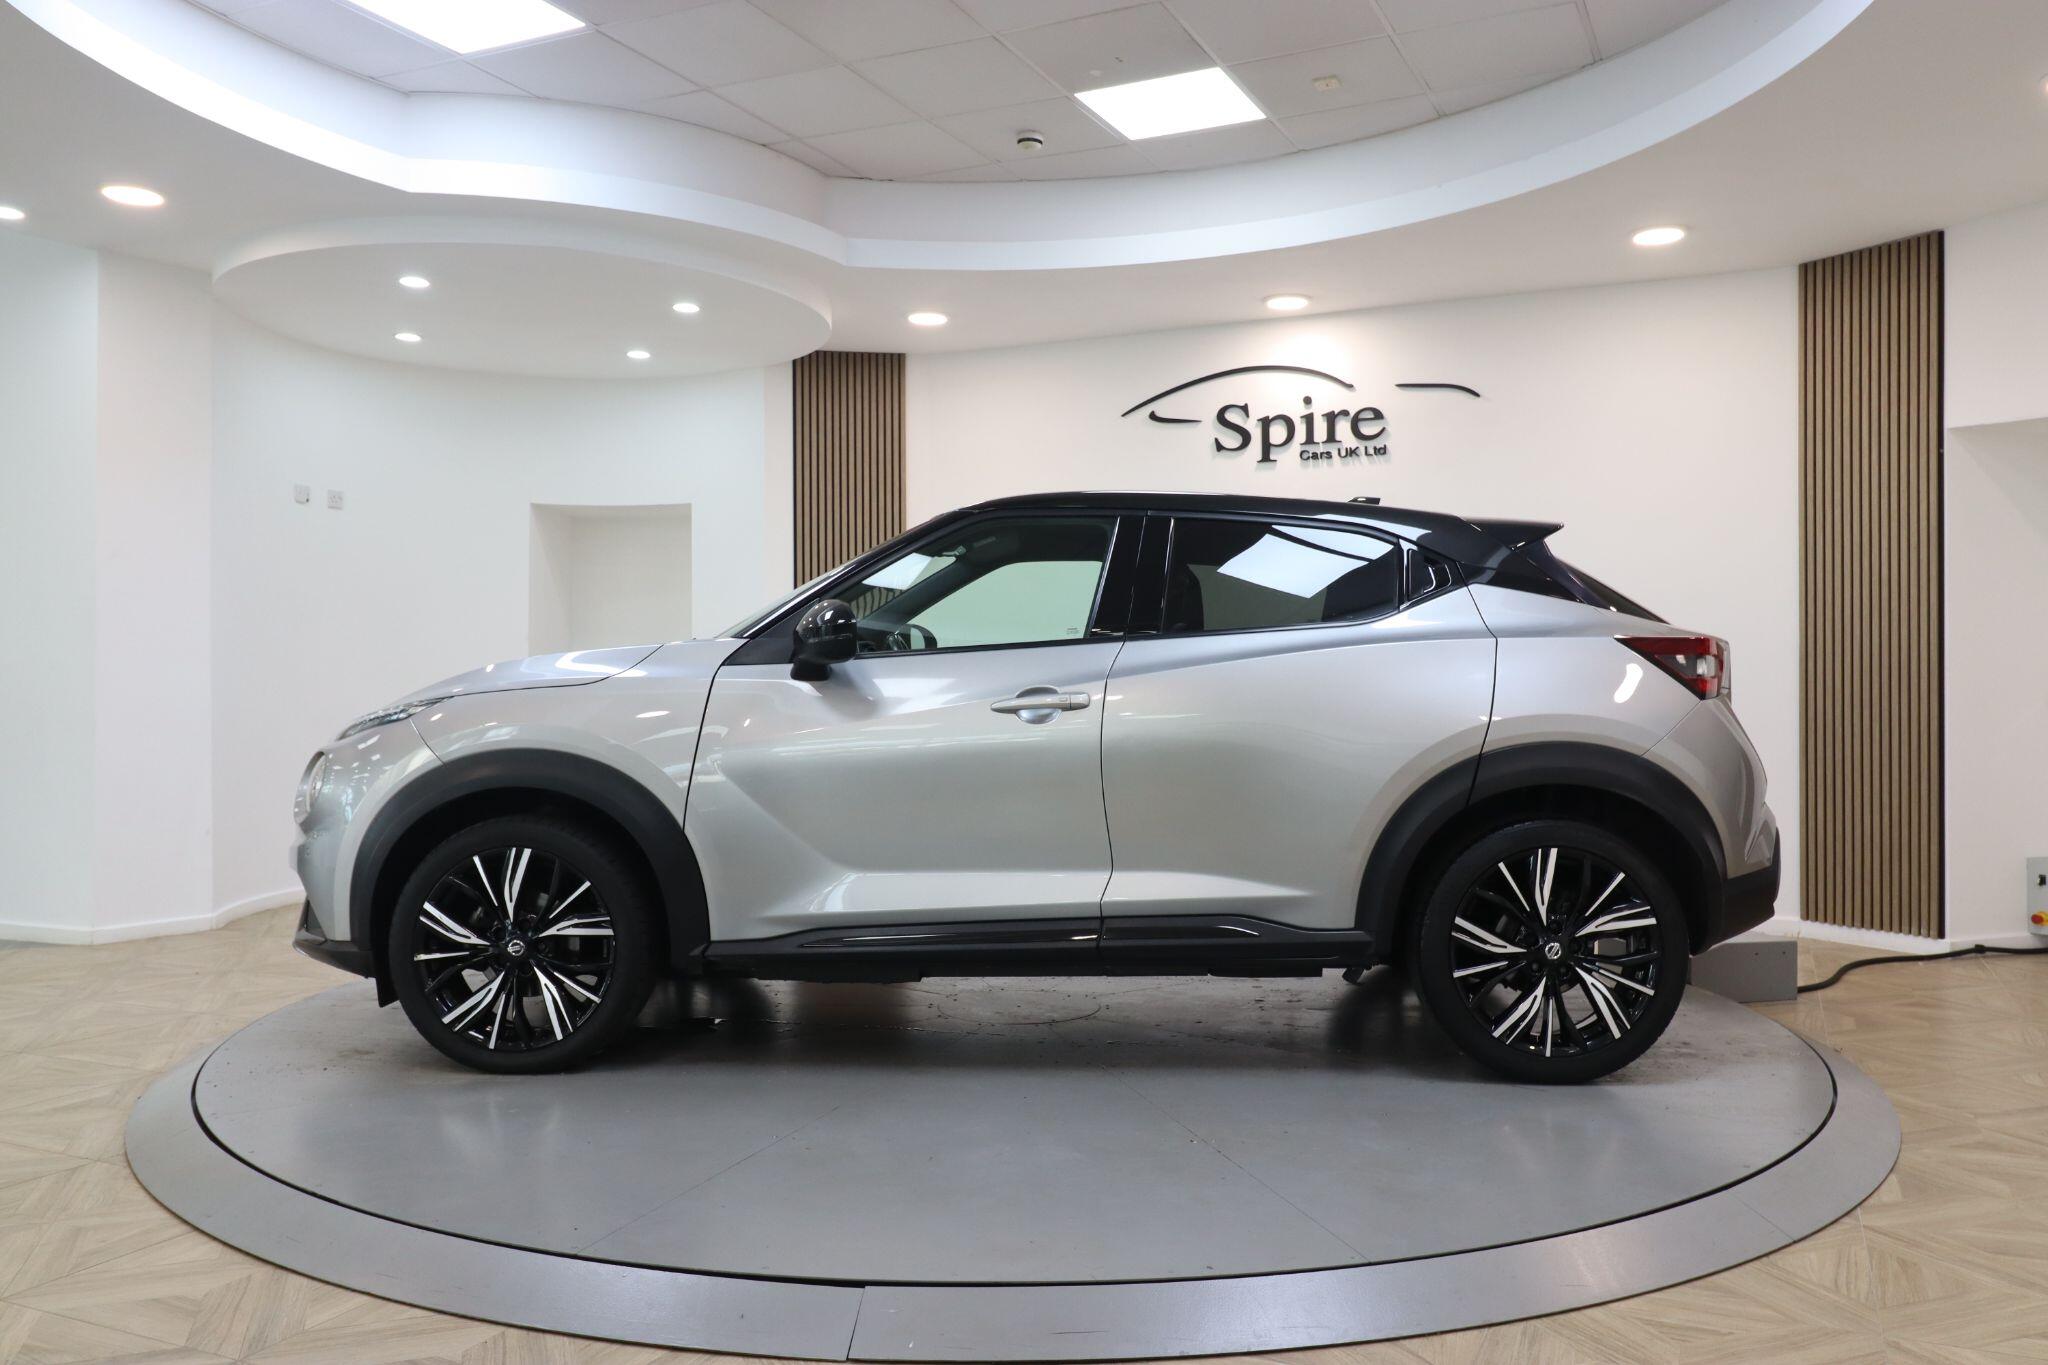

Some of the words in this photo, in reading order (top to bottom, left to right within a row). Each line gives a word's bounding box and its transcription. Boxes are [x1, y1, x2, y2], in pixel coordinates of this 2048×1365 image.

[1214, 396, 1387, 463] Spire
[1299, 448, 1333, 461] Cars
[1337, 445, 1360, 458] UK
[1364, 443, 1387, 457] Ltd
